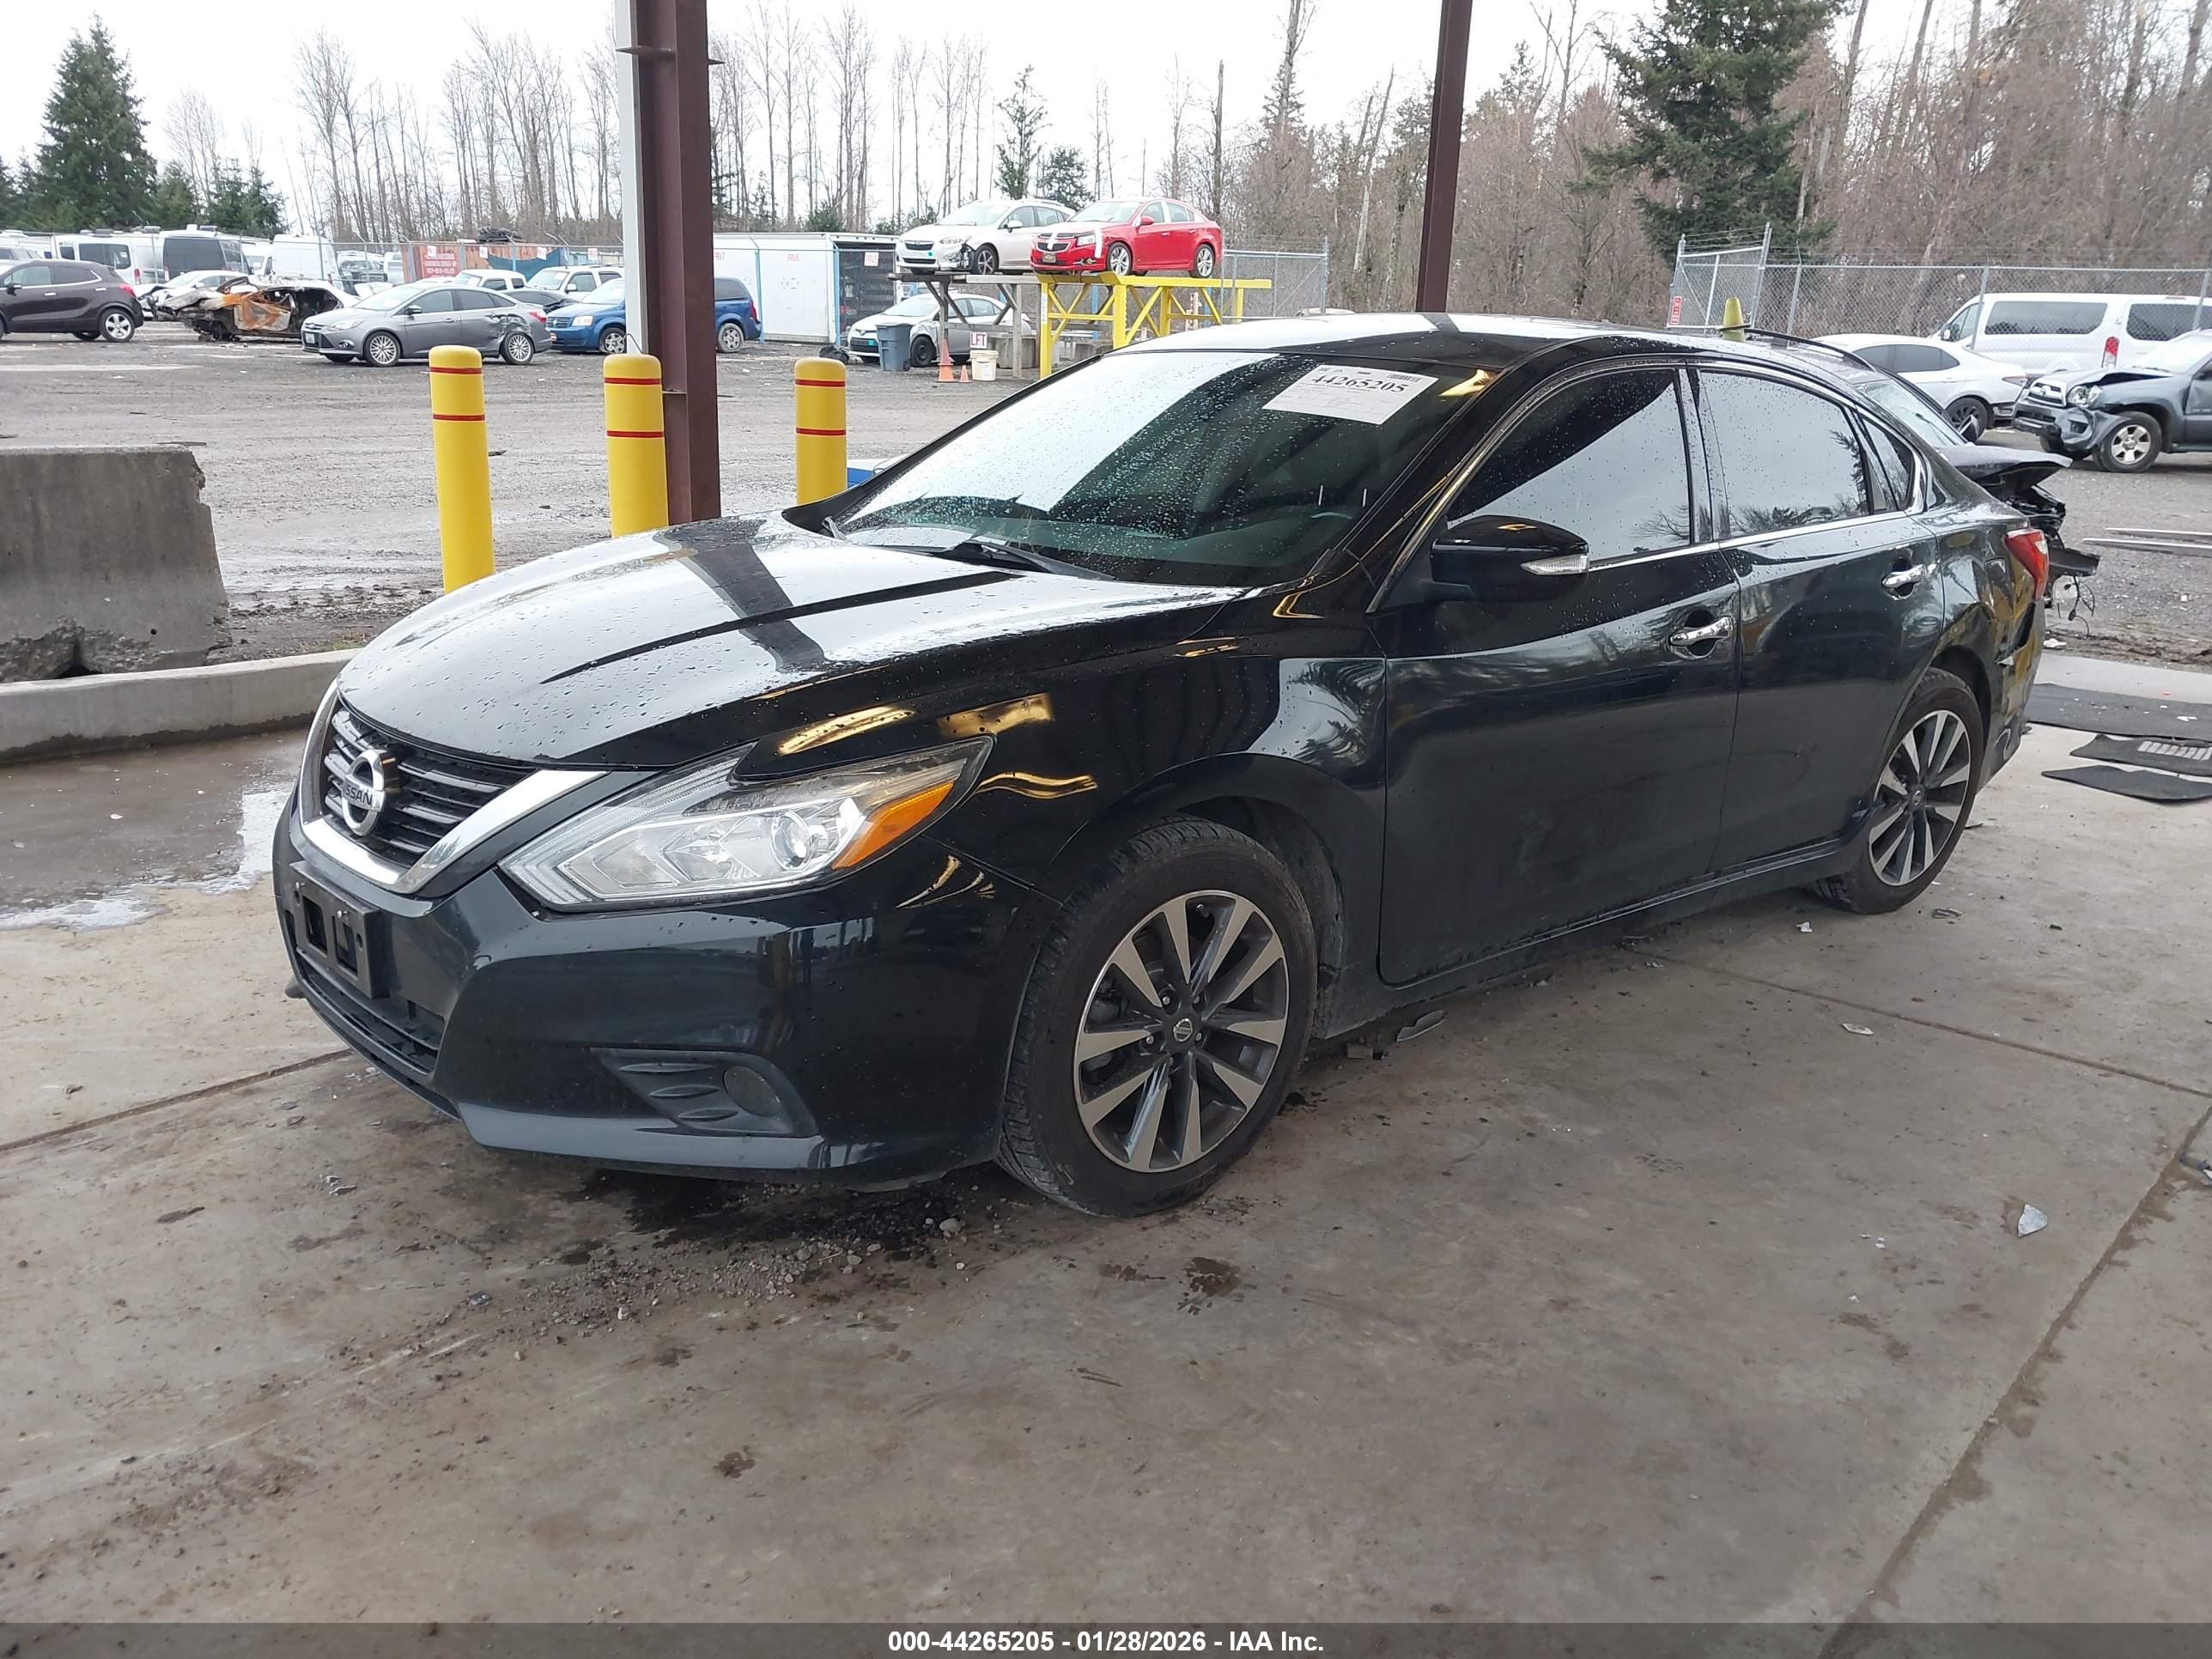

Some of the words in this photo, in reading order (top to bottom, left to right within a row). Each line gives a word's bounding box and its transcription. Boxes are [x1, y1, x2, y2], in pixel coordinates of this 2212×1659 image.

[971, 333, 986, 346] LFT
[1311, 374, 1409, 393] 44265205
[343, 782, 373, 805] SSAN
